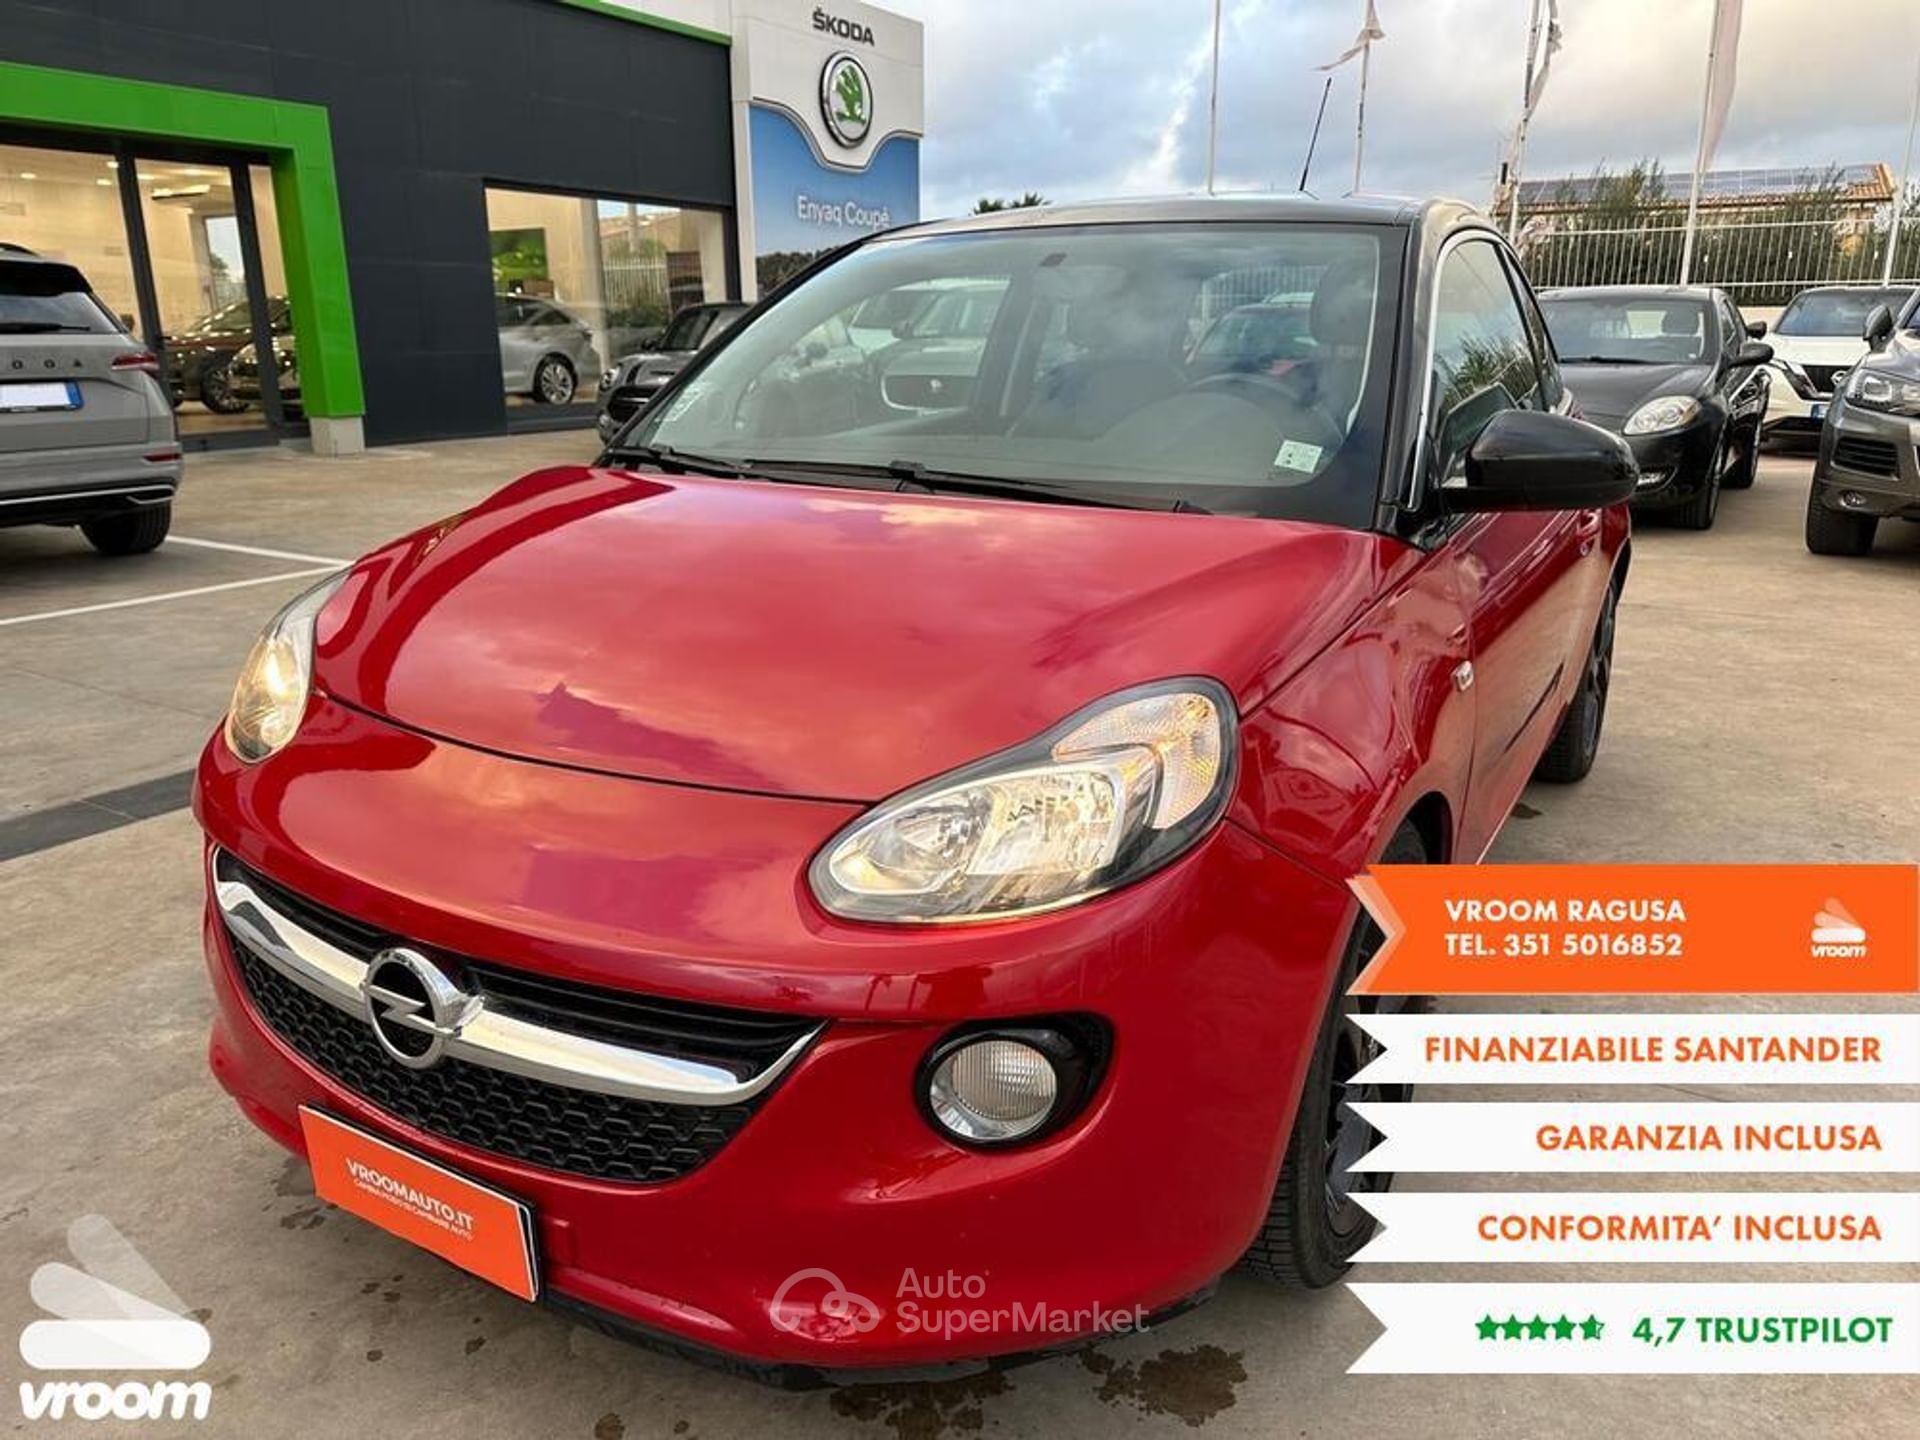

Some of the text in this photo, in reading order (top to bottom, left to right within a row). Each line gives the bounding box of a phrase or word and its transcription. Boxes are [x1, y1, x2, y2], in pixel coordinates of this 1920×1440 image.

[812, 7, 875, 46] ŠKODA
[797, 195, 891, 232] Enyaq Coupé
[346, 1157, 473, 1230] VROOMAUTO.IT
